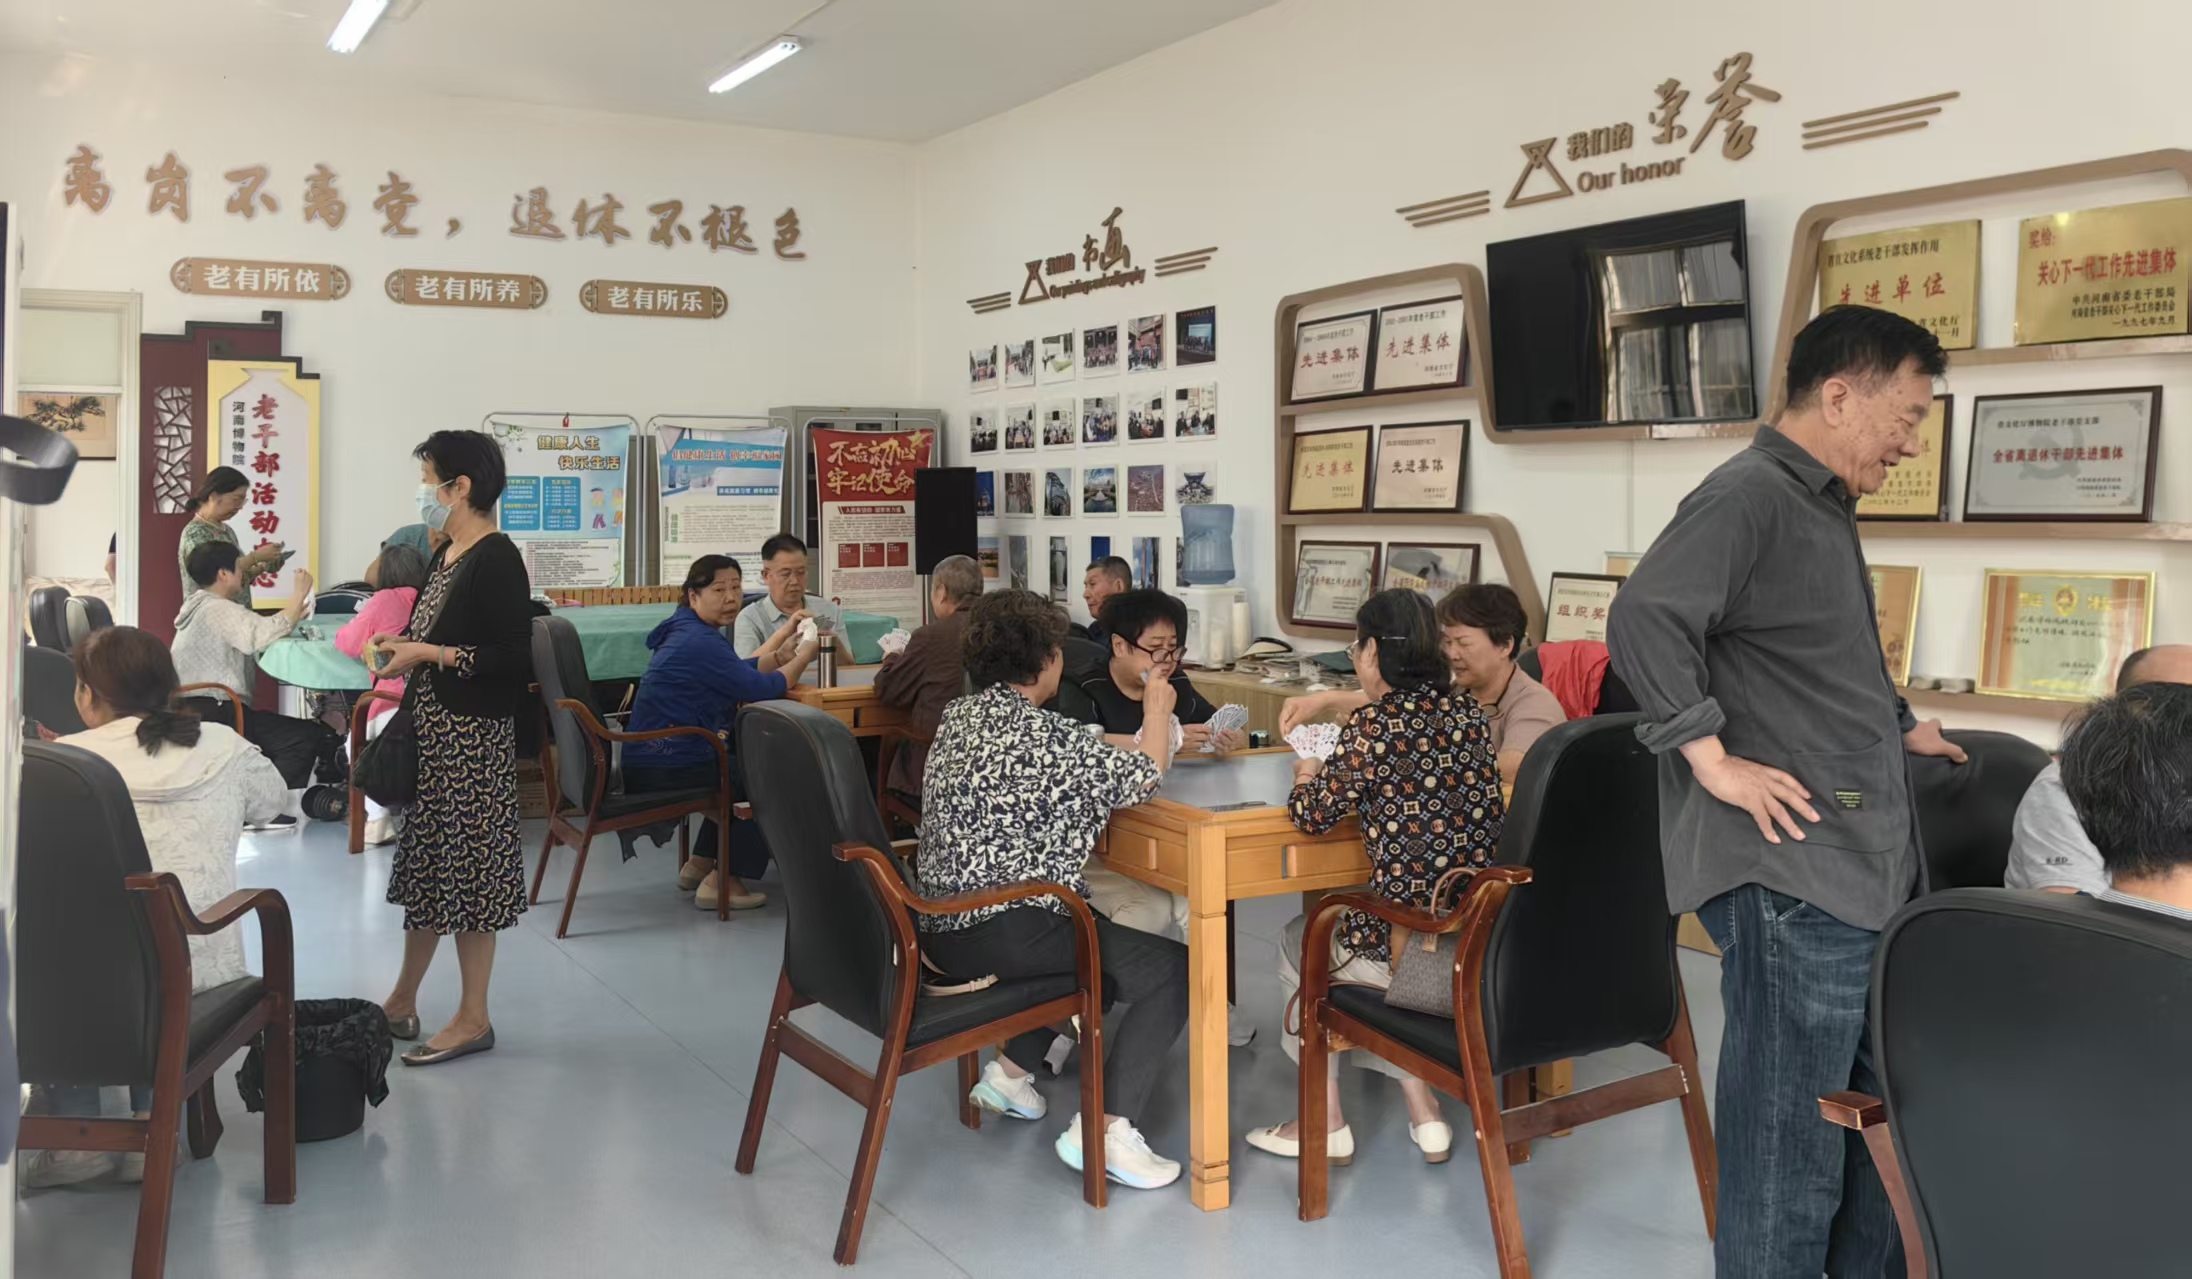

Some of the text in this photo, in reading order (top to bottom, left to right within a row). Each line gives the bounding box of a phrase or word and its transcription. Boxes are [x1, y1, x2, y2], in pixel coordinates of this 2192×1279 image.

[1567, 52, 1782, 161] 我们的 荣誉
[1577, 157, 1686, 192] Our honor
[203, 264, 321, 294] 老有所依
[2037, 246, 2177, 286] 关心下一代工作先进集体
[414, 275, 521, 302] 老有所养
[607, 285, 704, 312] 老有所乐
[1839, 272, 1946, 305] 先进单位
[1301, 345, 1360, 368] 先进集体
[1386, 331, 1451, 358] 先进集体
[232, 401, 246, 466] 河南博物院
[537, 435, 600, 450] 健康人生
[558, 455, 620, 470] 快乐生活
[827, 437, 917, 468] 不忘初心
[1392, 458, 1444, 474] 先进集体
[1993, 445, 2124, 464] 全省离退休干部先进集体
[827, 467, 915, 495] 牢记使命
[1557, 604, 1606, 620] 组织奖
